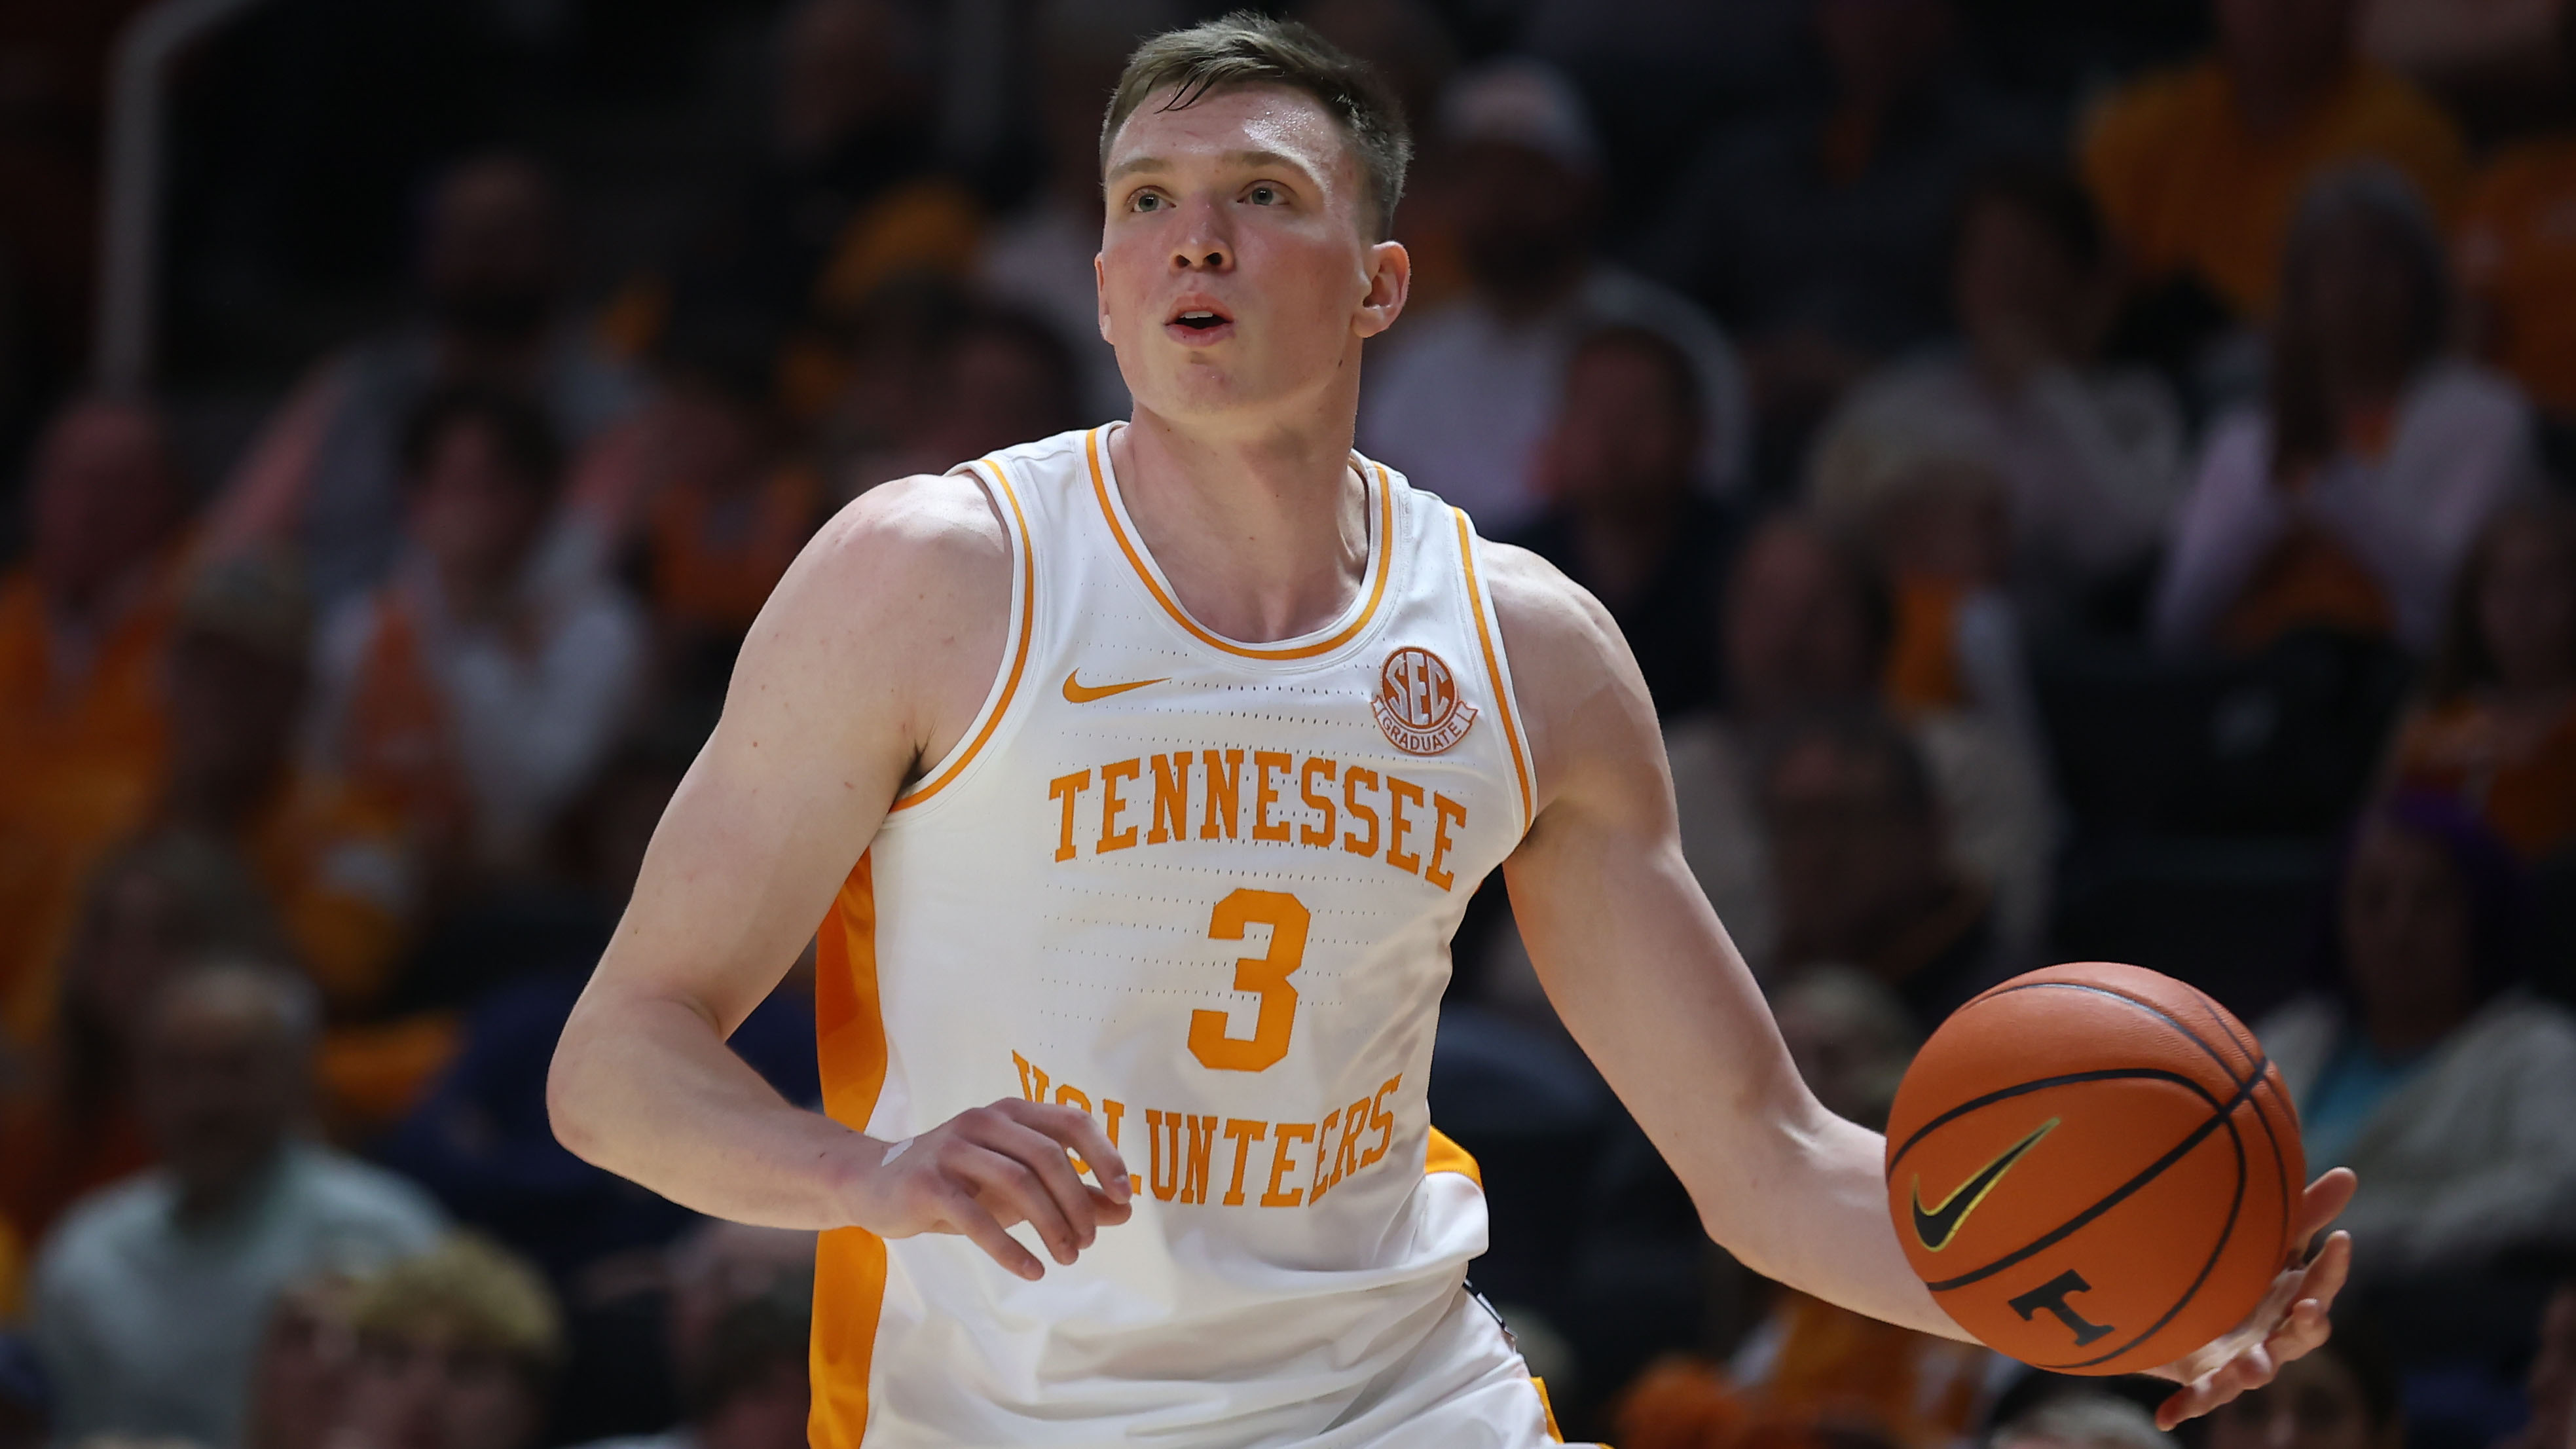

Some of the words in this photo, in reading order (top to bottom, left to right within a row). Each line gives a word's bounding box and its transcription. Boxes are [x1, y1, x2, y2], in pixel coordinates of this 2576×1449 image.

[1386, 651, 1450, 725] SEC
[1383, 717, 1462, 751] GRADUATE
[1049, 748, 1466, 892] TENNESSEE
[1187, 888, 1310, 1073] 3
[2008, 1268, 2115, 1346] T
